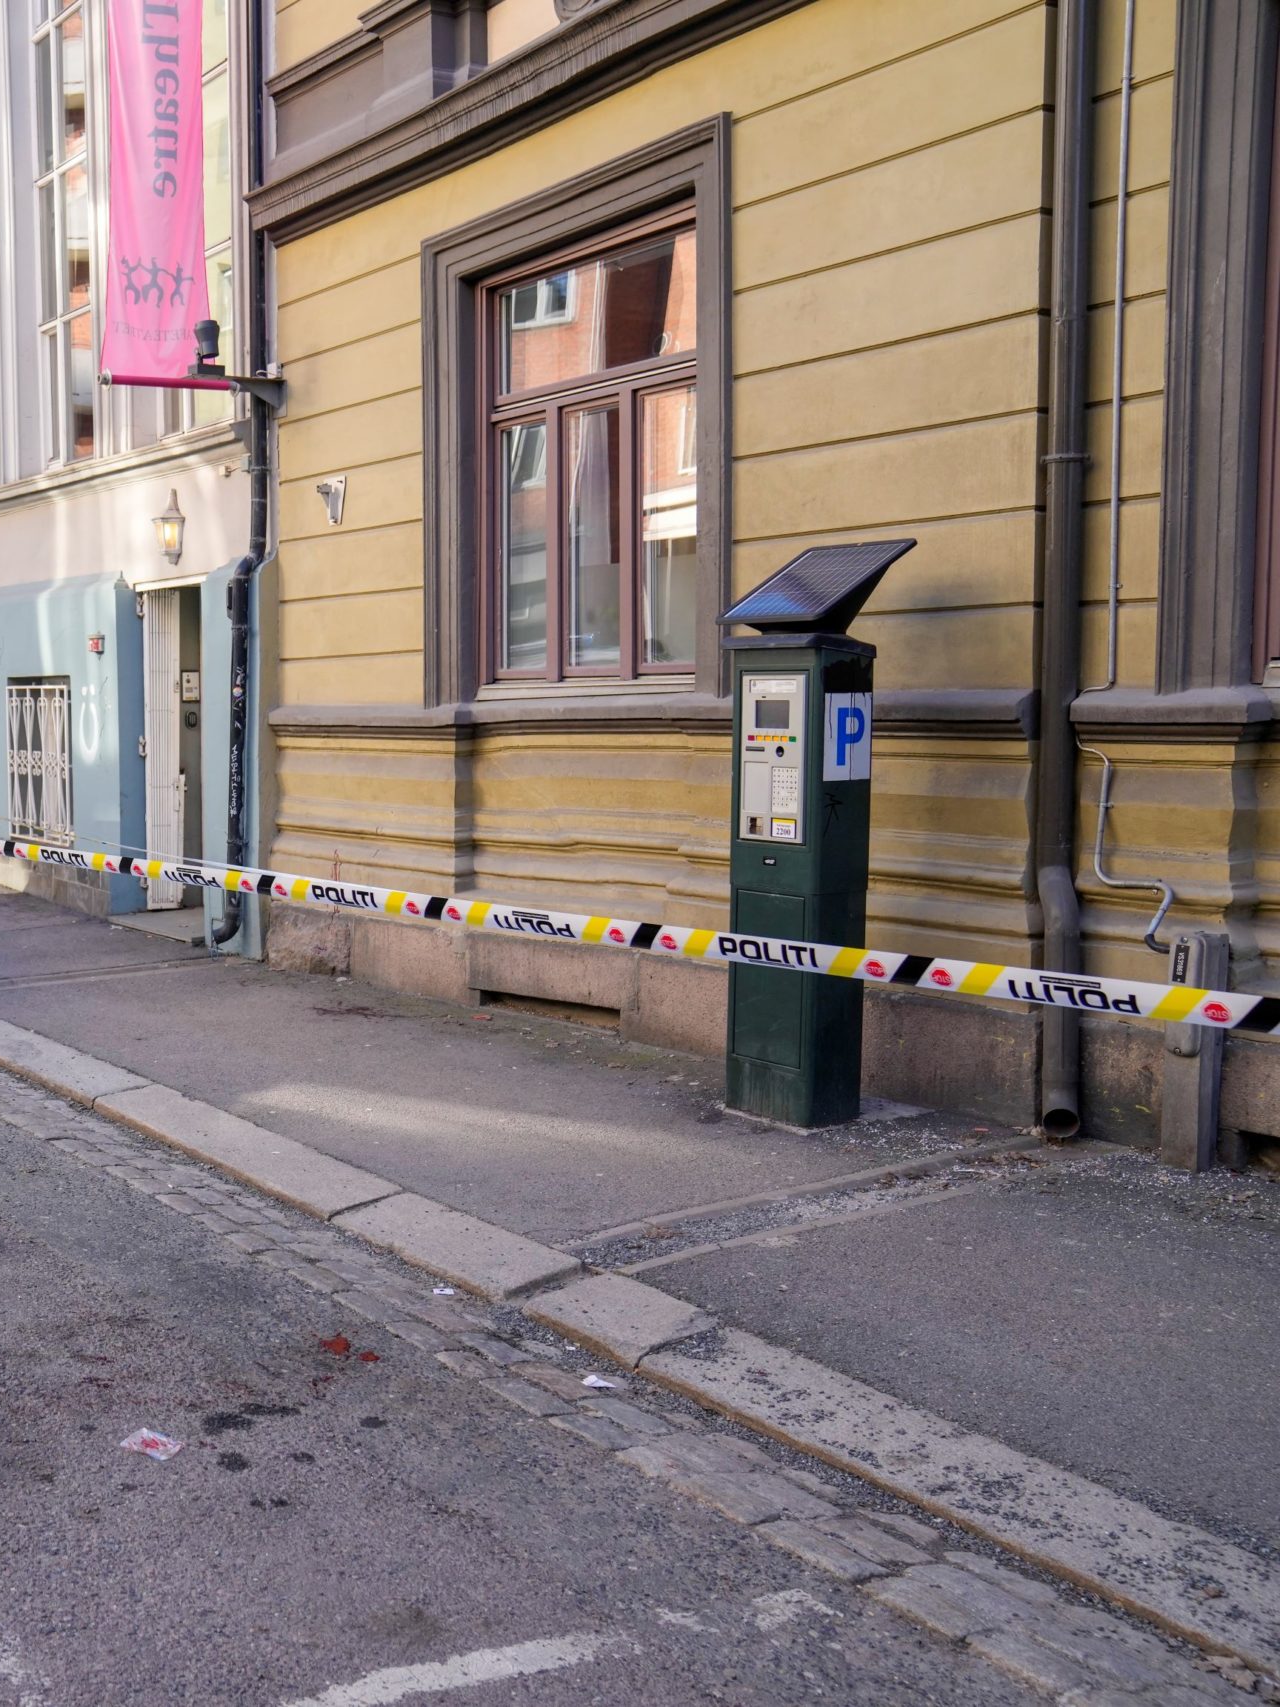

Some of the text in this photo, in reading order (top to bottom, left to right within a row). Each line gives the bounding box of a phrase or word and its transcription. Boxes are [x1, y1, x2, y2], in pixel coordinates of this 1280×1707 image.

[836, 706, 866, 767] P
[40, 849, 89, 868] POLITI
[164, 869, 222, 889] POLITI
[311, 885, 379, 909] POLITI
[493, 914, 577, 939] POLITI
[718, 936, 820, 969] POLITI
[1007, 979, 1142, 1015] POLITI
[1205, 1009, 1230, 1019] STOP
